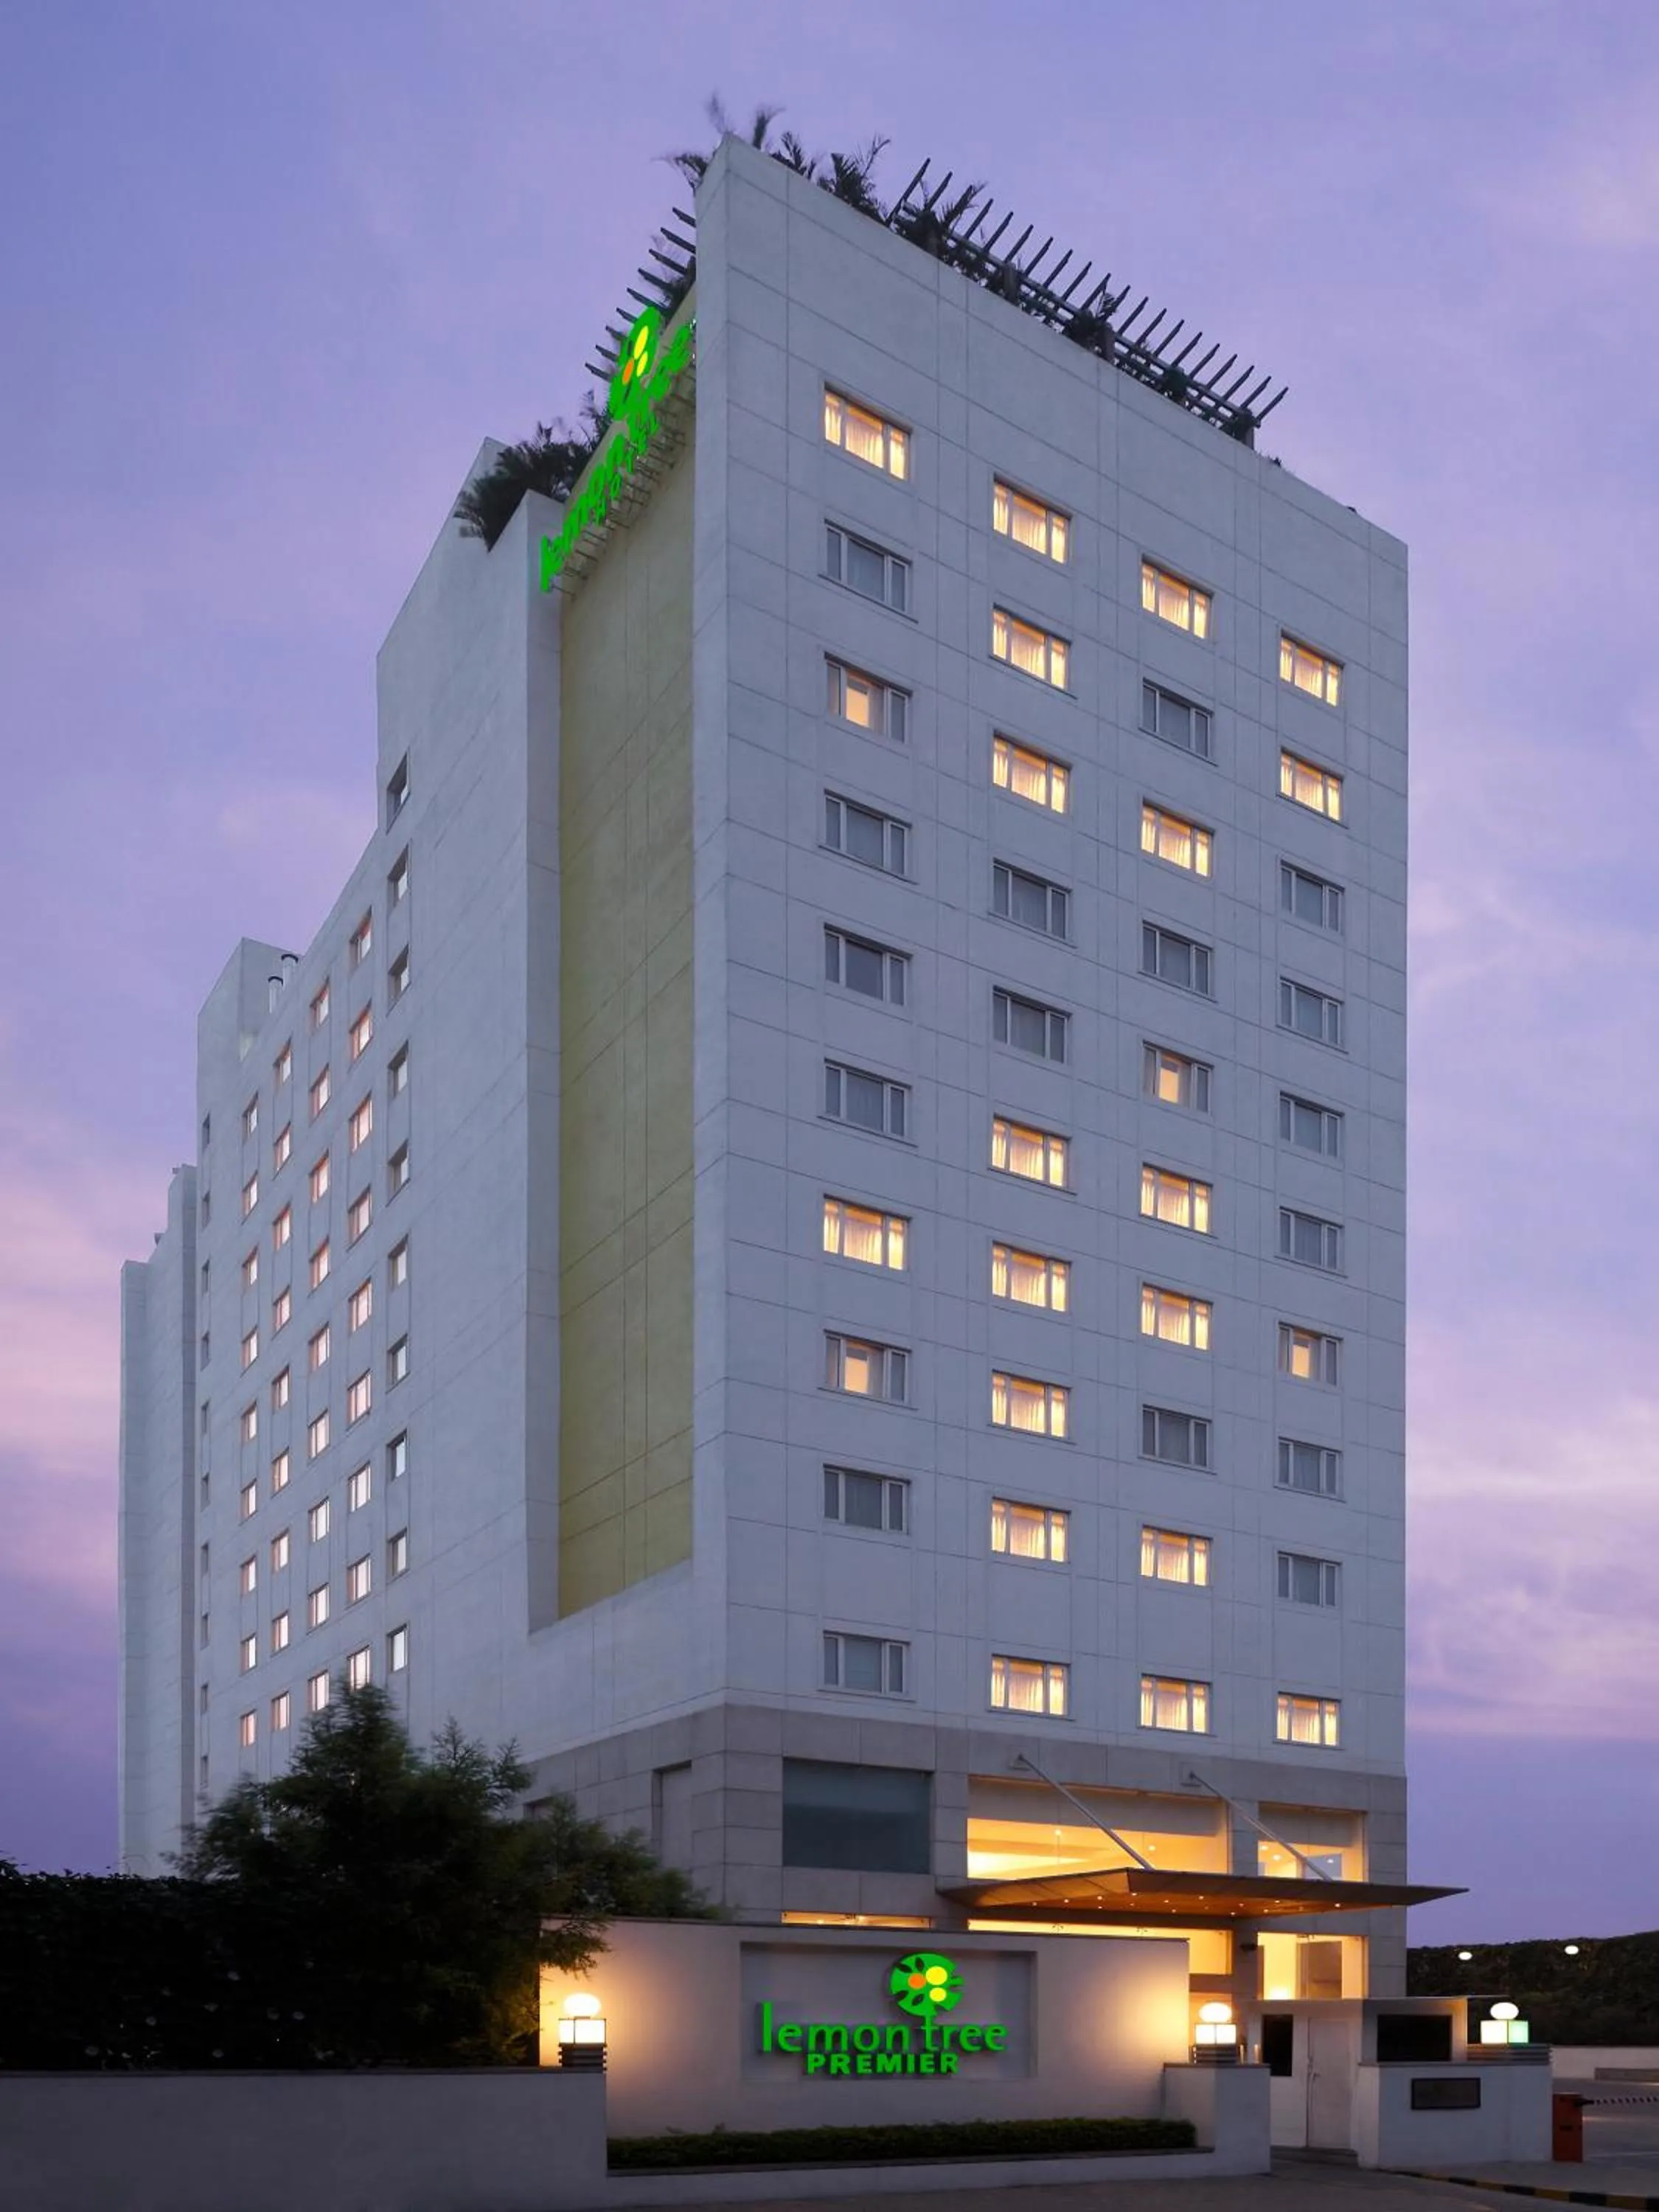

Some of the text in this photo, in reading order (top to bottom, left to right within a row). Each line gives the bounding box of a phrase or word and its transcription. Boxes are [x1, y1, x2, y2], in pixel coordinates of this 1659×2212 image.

[762, 2001, 1009, 2053] lemon tree
[807, 2053, 959, 2074] PREMIER
